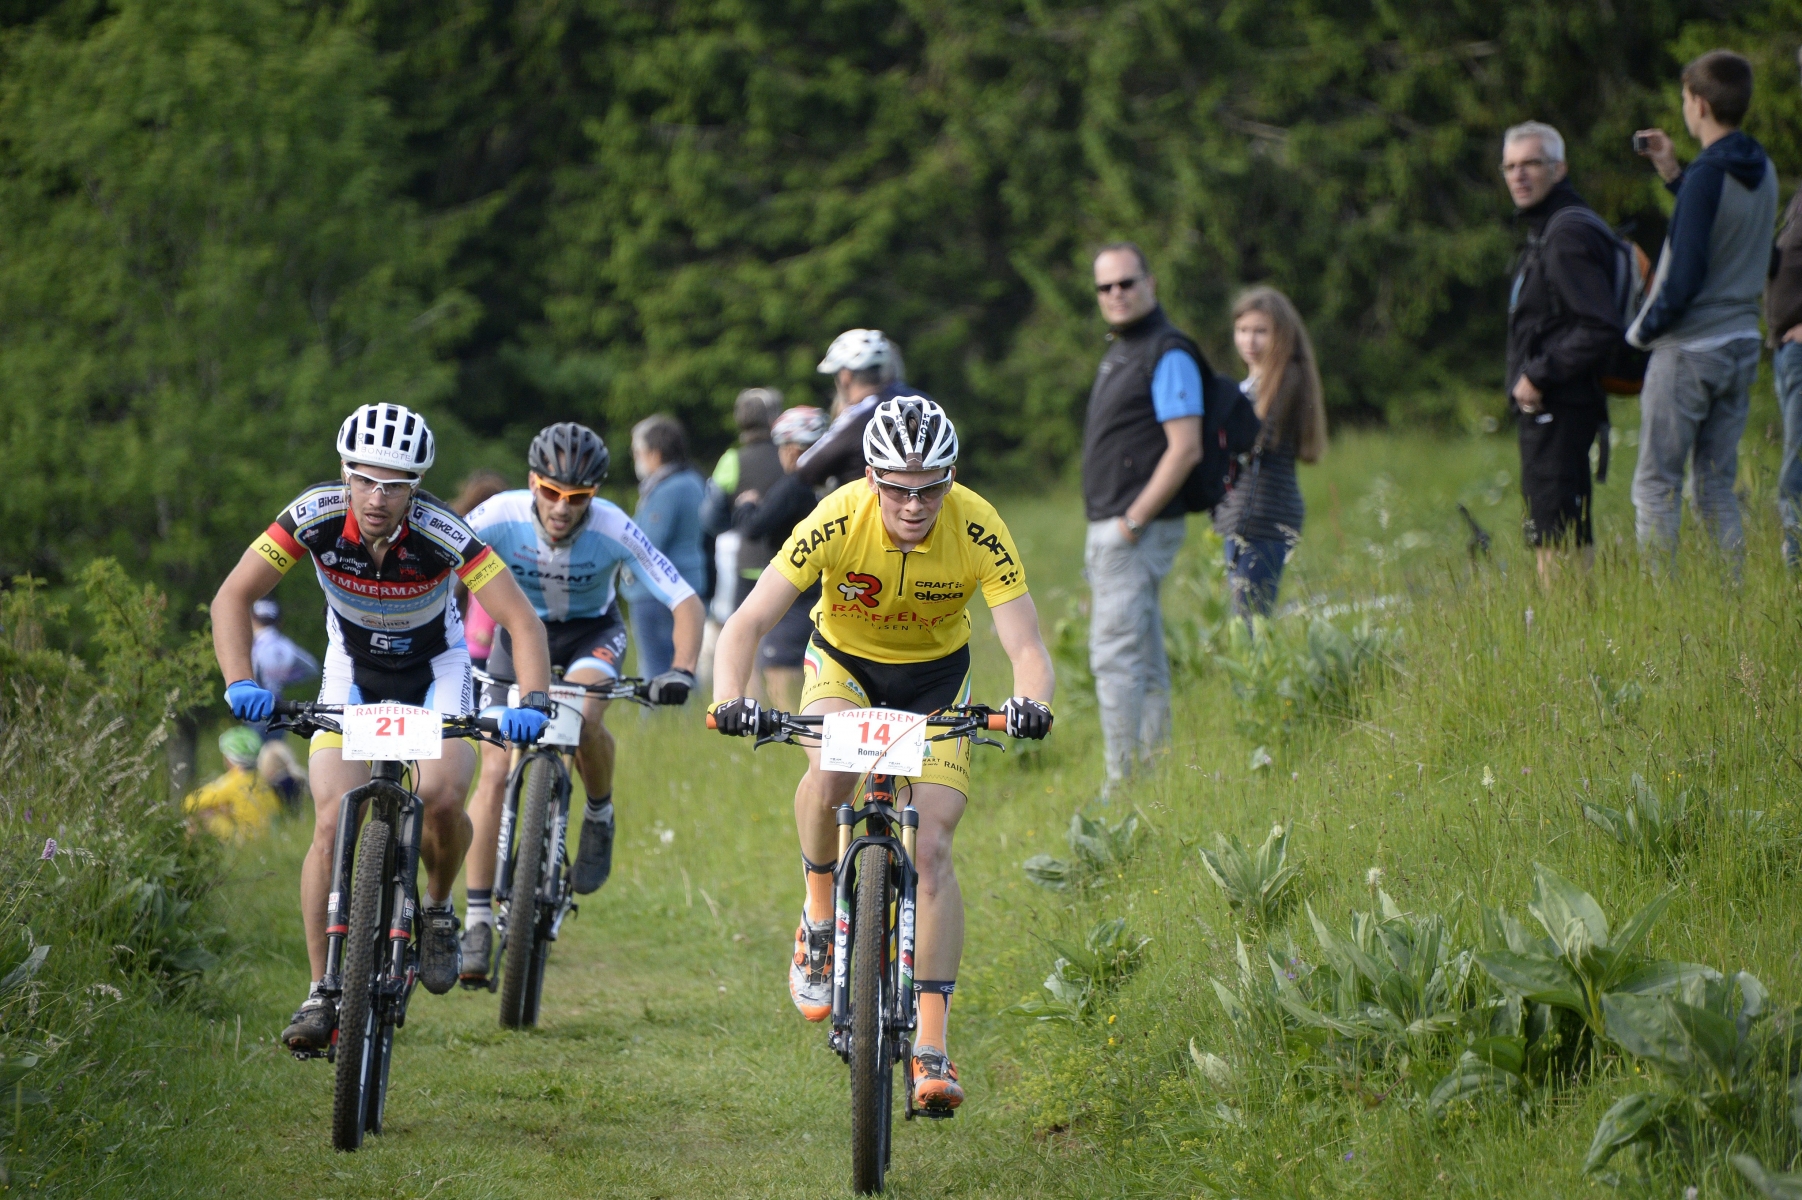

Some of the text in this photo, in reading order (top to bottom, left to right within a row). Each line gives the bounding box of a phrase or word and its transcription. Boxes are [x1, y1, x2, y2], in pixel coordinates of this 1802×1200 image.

[790, 515, 848, 568] CRAFT
[966, 519, 1014, 567] RAFT
[528, 570, 597, 583] GIANT
[914, 581, 954, 589] CRAFT
[914, 590, 964, 601] elexa
[370, 632, 413, 652] GS
[460, 664, 472, 718] IMMERMANN
[356, 706, 430, 716] RAIFFEISEN
[838, 710, 914, 723] RAIFFEISEN
[376, 717, 405, 736] 21
[858, 721, 890, 745] 14
[858, 748, 888, 757] Romain
